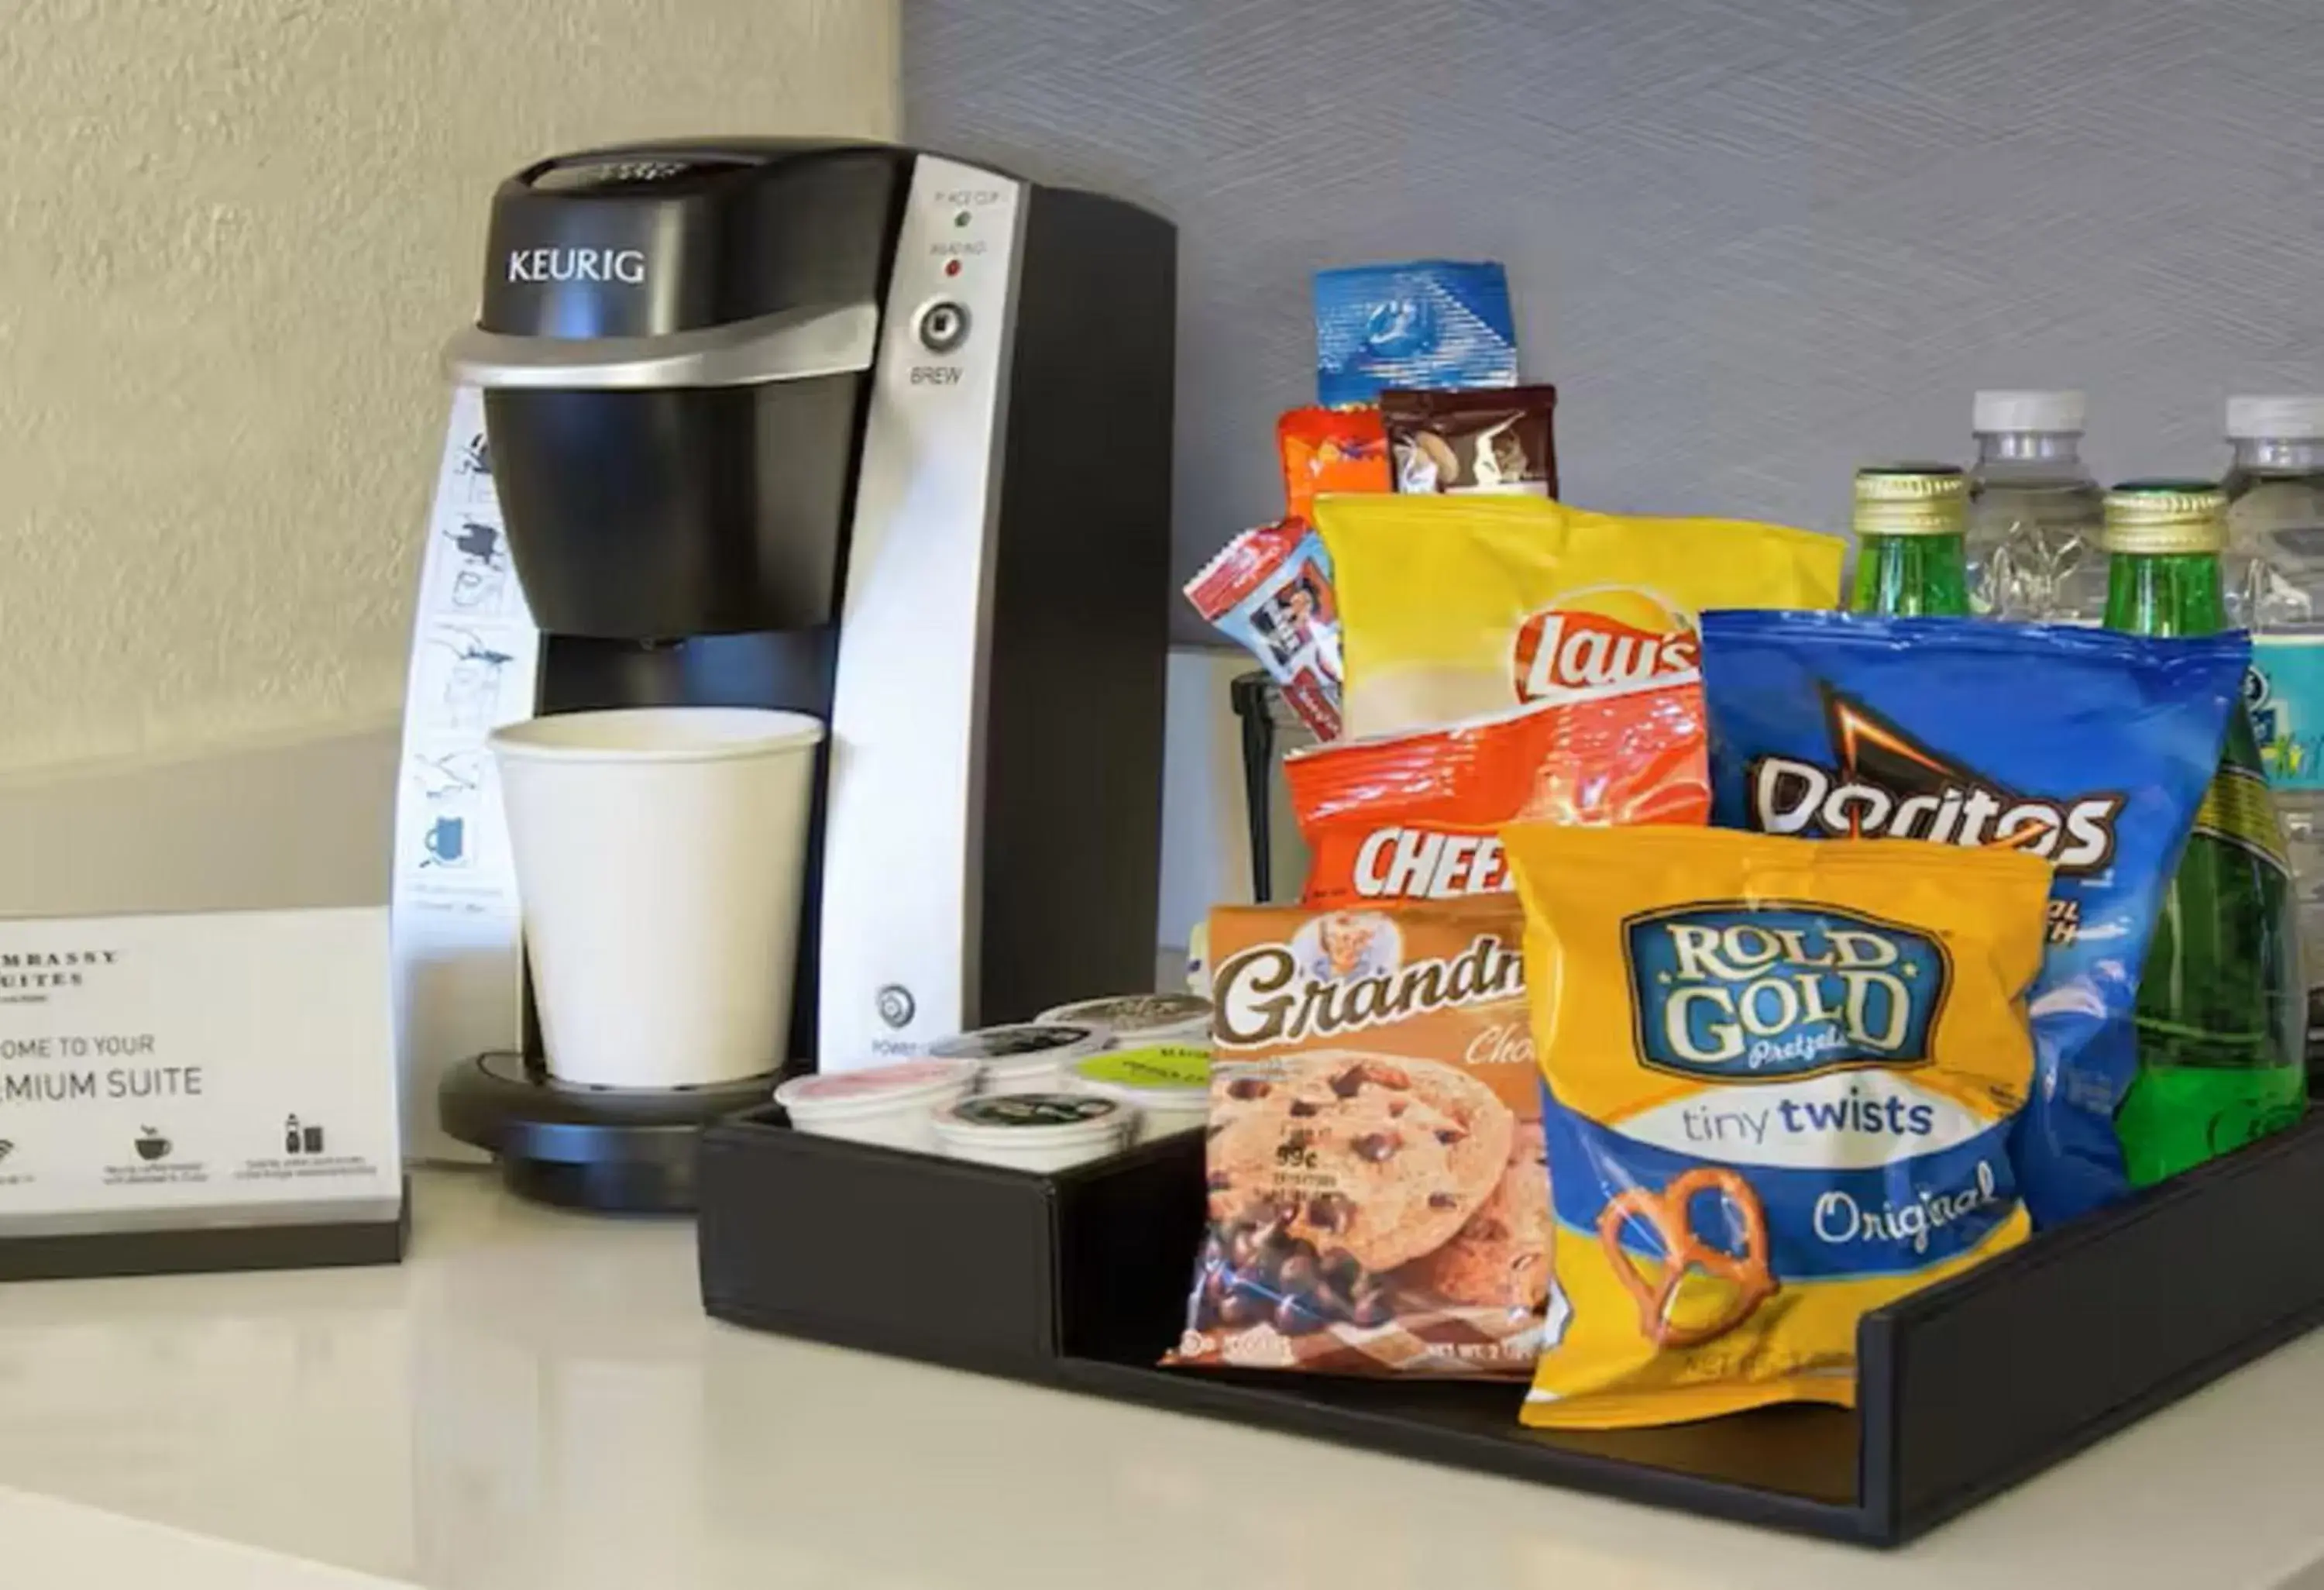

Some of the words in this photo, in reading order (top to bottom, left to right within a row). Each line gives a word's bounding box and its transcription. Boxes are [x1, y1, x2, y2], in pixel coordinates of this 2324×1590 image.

[508, 248, 646, 284] KEURIG
[909, 365, 964, 386] BREW
[1527, 615, 1699, 696] Lay's
[1757, 756, 2115, 866] Doritos
[1353, 827, 1518, 899] CHEE
[0, 951, 117, 966] MBASSY
[0, 973, 83, 988] UITES
[1666, 922, 1899, 981] ROLD
[1666, 970, 1910, 1064] GOLD
[1, 1038, 51, 1060] OME
[60, 1036, 88, 1057] TO
[93, 1034, 156, 1056] YOUR
[0, 1072, 96, 1102] MIUM
[107, 1067, 202, 1099] SUITE
[1683, 1106, 1769, 1144] tiny
[1779, 1086, 1933, 1135] twists
[1813, 1161, 1994, 1253] Original
